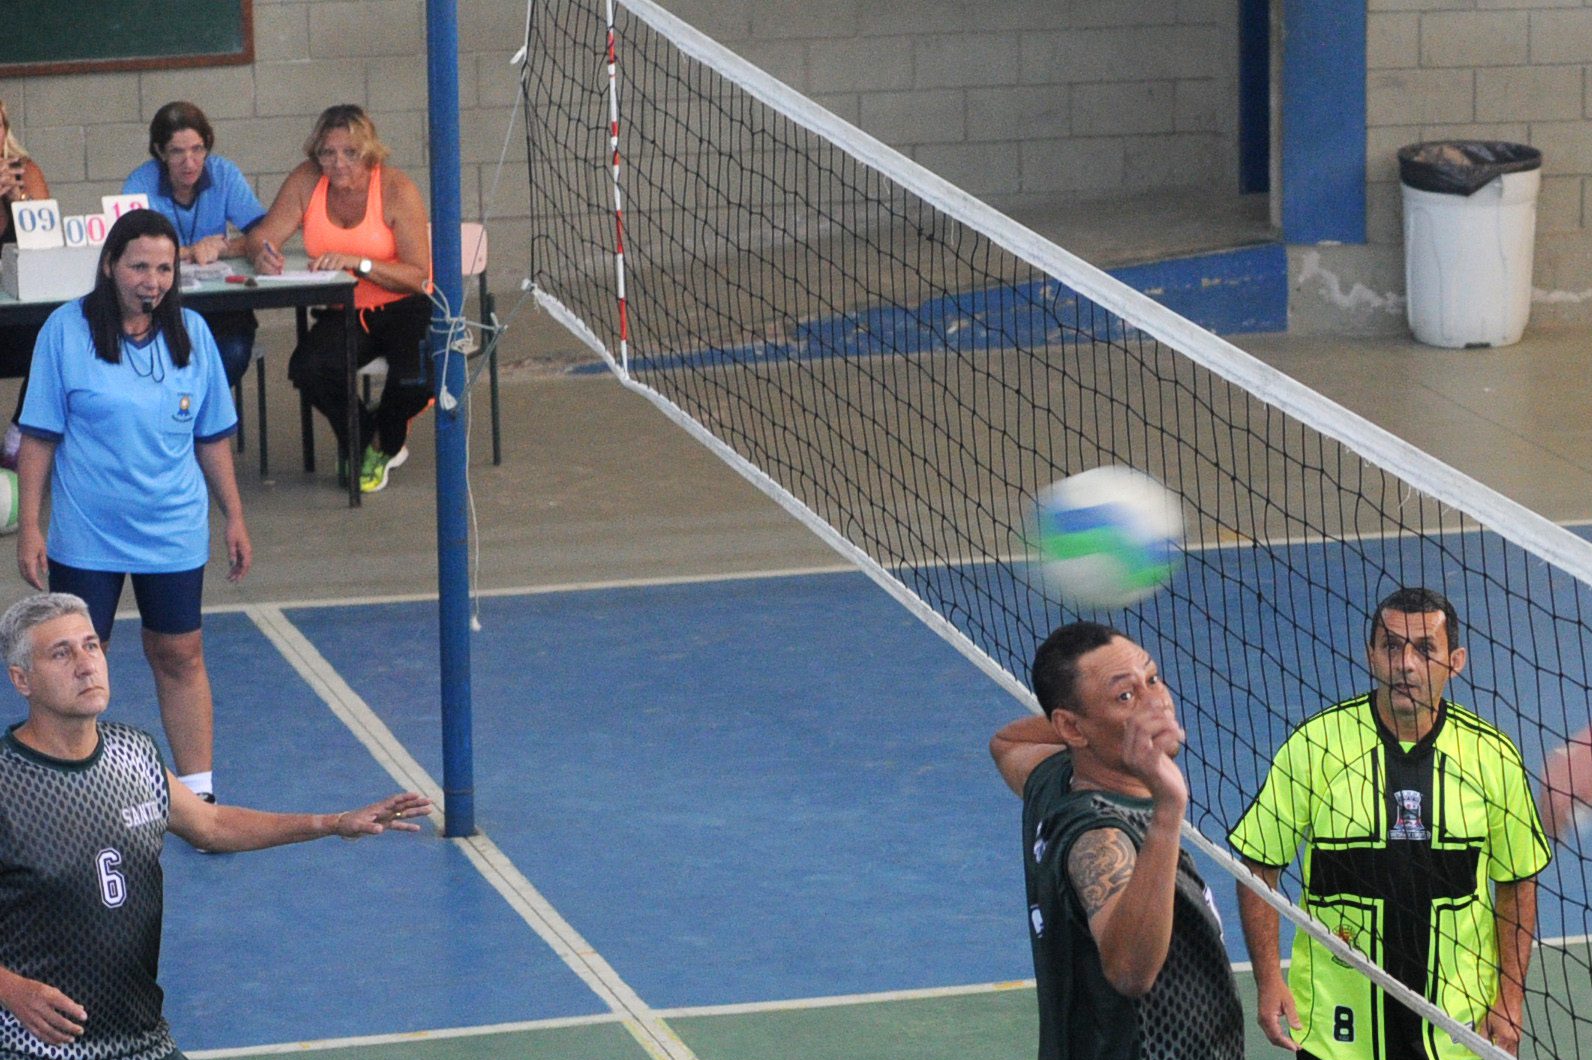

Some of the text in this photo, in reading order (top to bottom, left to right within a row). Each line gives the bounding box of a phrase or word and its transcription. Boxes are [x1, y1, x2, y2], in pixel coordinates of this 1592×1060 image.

[18, 207, 56, 233] 09
[96, 847, 127, 908] 6
[1333, 1005, 1354, 1042] 8
